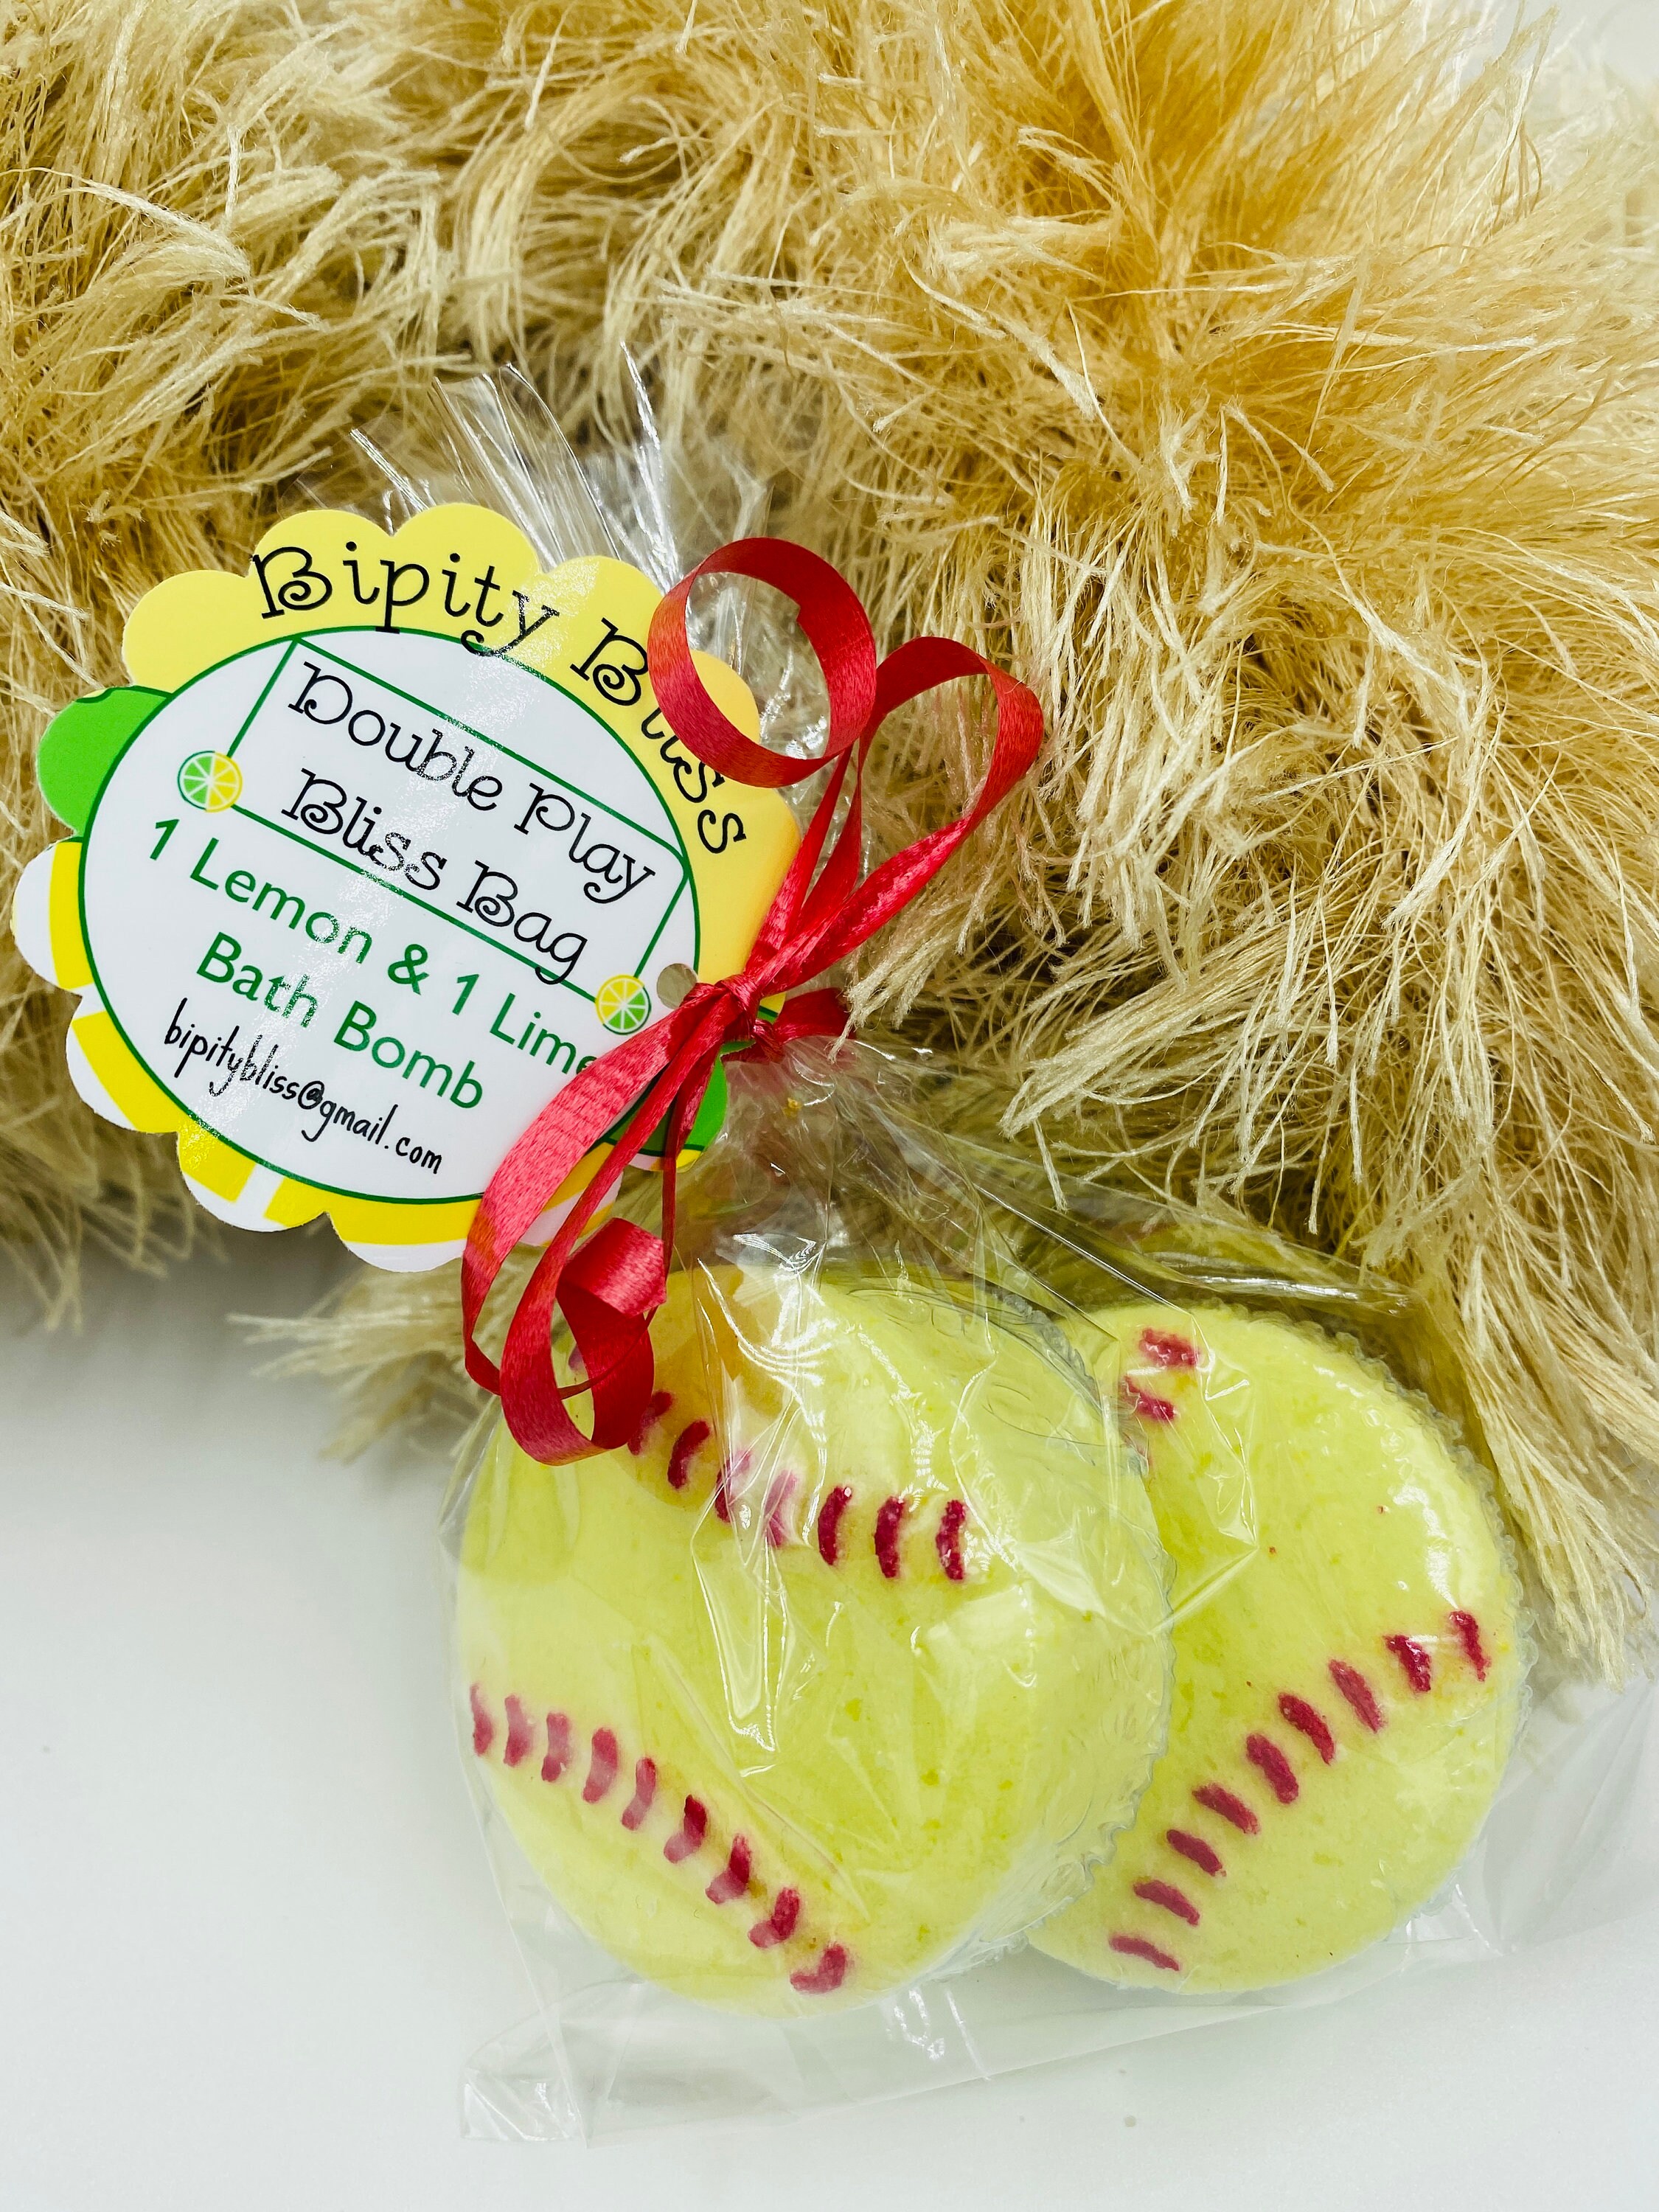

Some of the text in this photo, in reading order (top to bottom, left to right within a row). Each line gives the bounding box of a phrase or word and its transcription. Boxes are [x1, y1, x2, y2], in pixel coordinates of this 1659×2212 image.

[252, 542, 560, 658] Bipity
[281, 768, 588, 985] Bliss Bag
[288, 661, 655, 904] Double Play
[148, 818, 180, 861] 1
[189, 837, 373, 964] Lemon
[387, 943, 431, 995] &
[451, 973, 480, 1016] 1
[164, 997, 442, 1174] bipitybliss@gmail.com
[196, 932, 484, 1110] Bath Bomb
